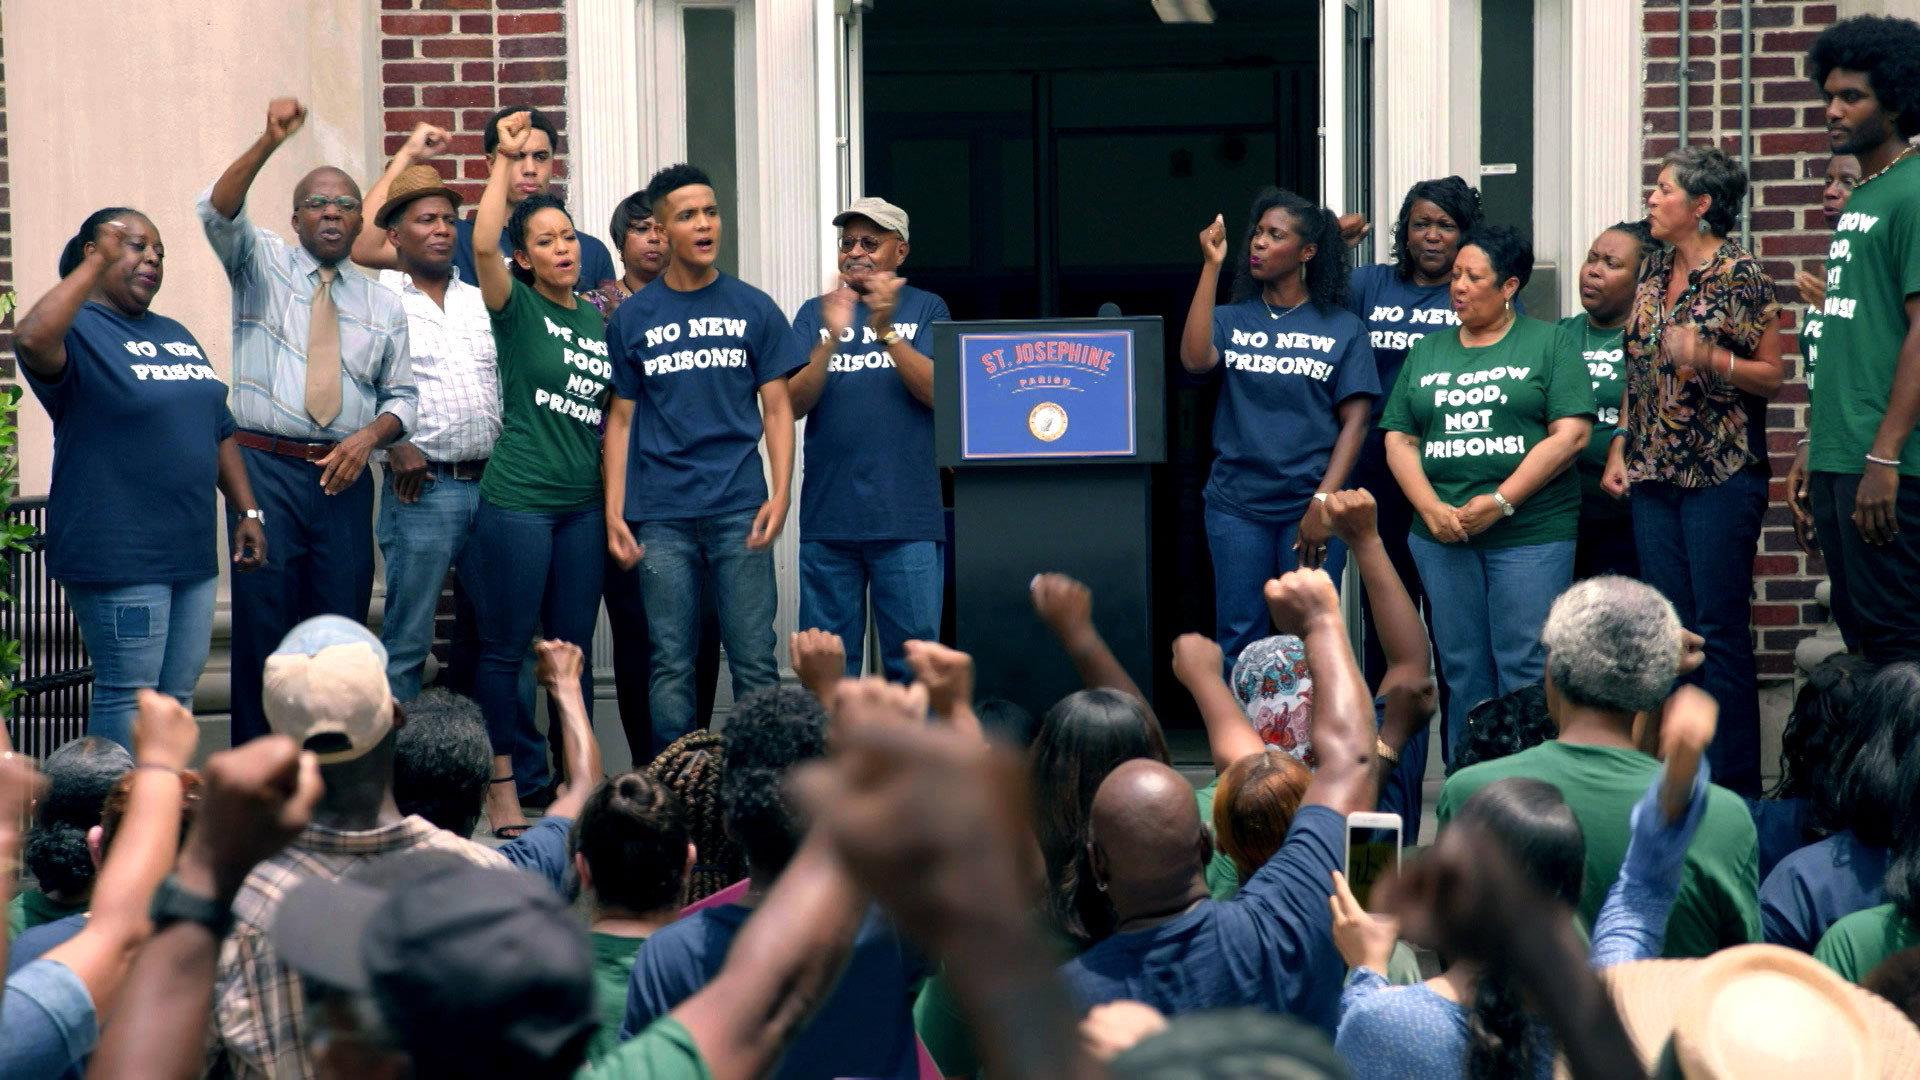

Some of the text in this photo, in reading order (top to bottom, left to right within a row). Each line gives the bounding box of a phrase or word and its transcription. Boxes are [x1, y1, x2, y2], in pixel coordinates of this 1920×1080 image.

[1369, 305, 1405, 323] NO
[644, 316, 747, 348] NO NEW
[862, 322, 918, 344] NW
[1231, 327, 1336, 354] NO NEW
[643, 347, 748, 377] PRISONS!
[827, 350, 897, 373] RISON
[980, 341, 1115, 374] ST. JOSEPHINE
[1224, 349, 1334, 382] PRISONS!
[130, 363, 222, 382] PRISON
[1420, 365, 1531, 388] WE GROW
[565, 373, 605, 401] NOT
[1434, 384, 1508, 408] FOOD,
[1444, 409, 1494, 434] NOT
[1425, 435, 1525, 459] PRISONS!
